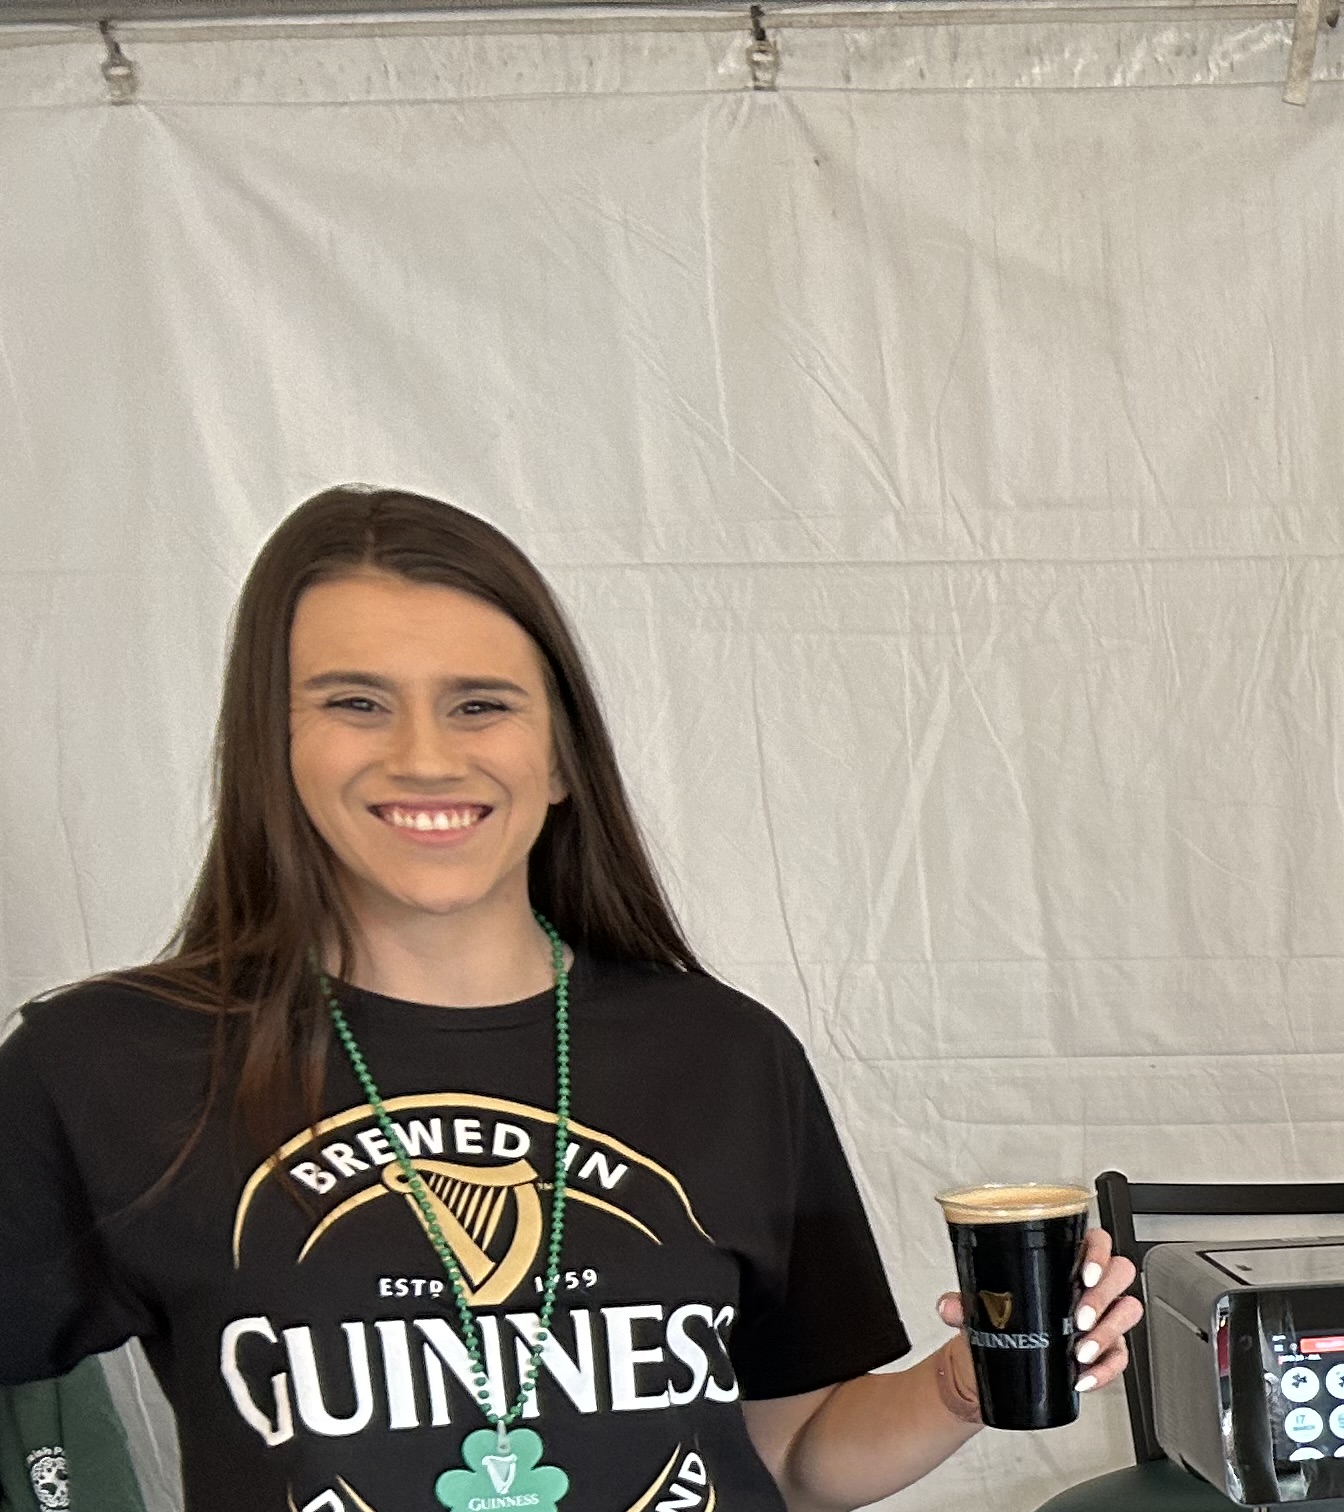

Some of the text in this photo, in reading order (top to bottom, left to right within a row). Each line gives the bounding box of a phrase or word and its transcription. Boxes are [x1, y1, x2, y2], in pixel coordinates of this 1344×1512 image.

[290, 1118, 628, 1194] BREWED IN
[220, 1303, 740, 1447] GUINNESS
[468, 1493, 540, 1512] GUINNESS
